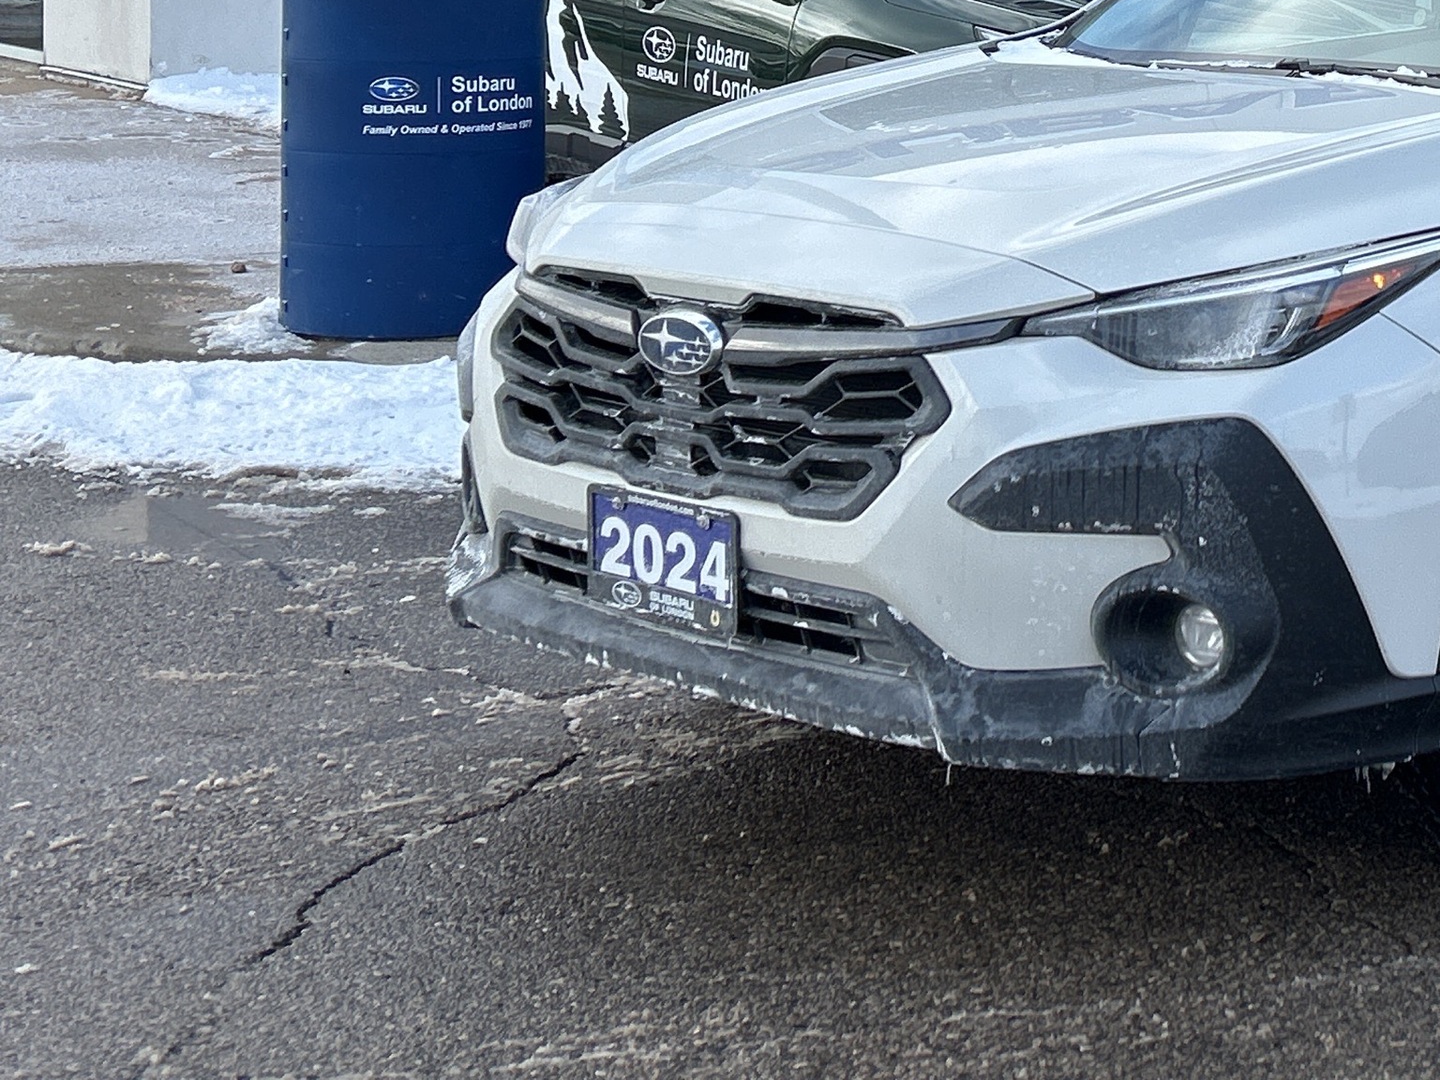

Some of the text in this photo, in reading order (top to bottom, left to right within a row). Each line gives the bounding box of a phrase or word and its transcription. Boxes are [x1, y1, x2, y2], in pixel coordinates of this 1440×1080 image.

[695, 35, 750, 71] Subaru
[451, 76, 515, 93] Subaru
[636, 64, 679, 86] SUBARU
[693, 68, 710, 93] of
[362, 105, 427, 114] SUBARU
[451, 94, 533, 113] of London
[363, 125, 398, 136] Family
[400, 124, 438, 135] Owned
[440, 125, 449, 134] &
[451, 122, 495, 134] Operated
[496, 121, 517, 131] Since
[600, 516, 729, 601] 2024
[650, 590, 694, 611] SUBARU
